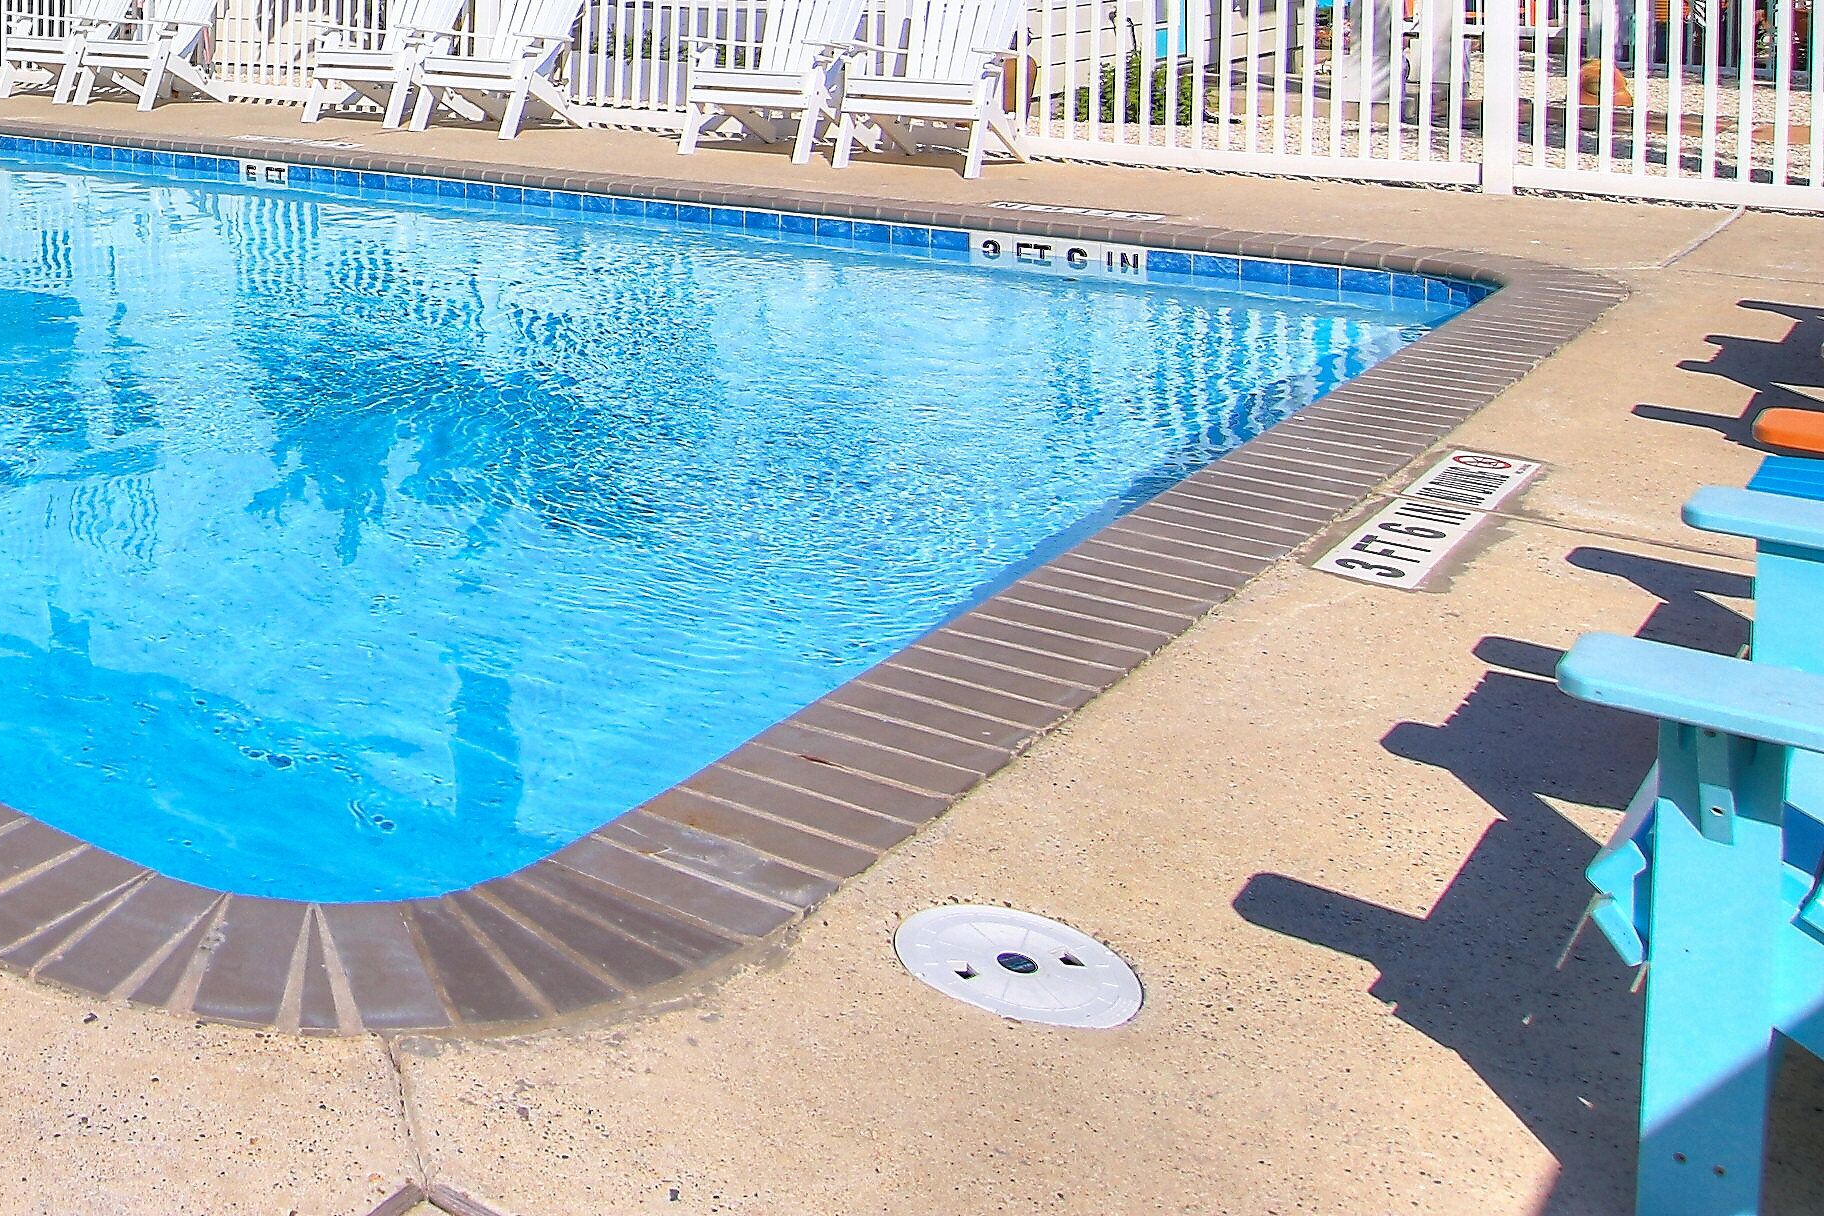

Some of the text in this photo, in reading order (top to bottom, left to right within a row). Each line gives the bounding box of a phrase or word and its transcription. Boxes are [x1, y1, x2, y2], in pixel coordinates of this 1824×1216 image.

[1428, 466, 1510, 495] DIVING
[1415, 487, 1486, 506] NO
[1334, 502, 1472, 579] 3 FT 6 IN
